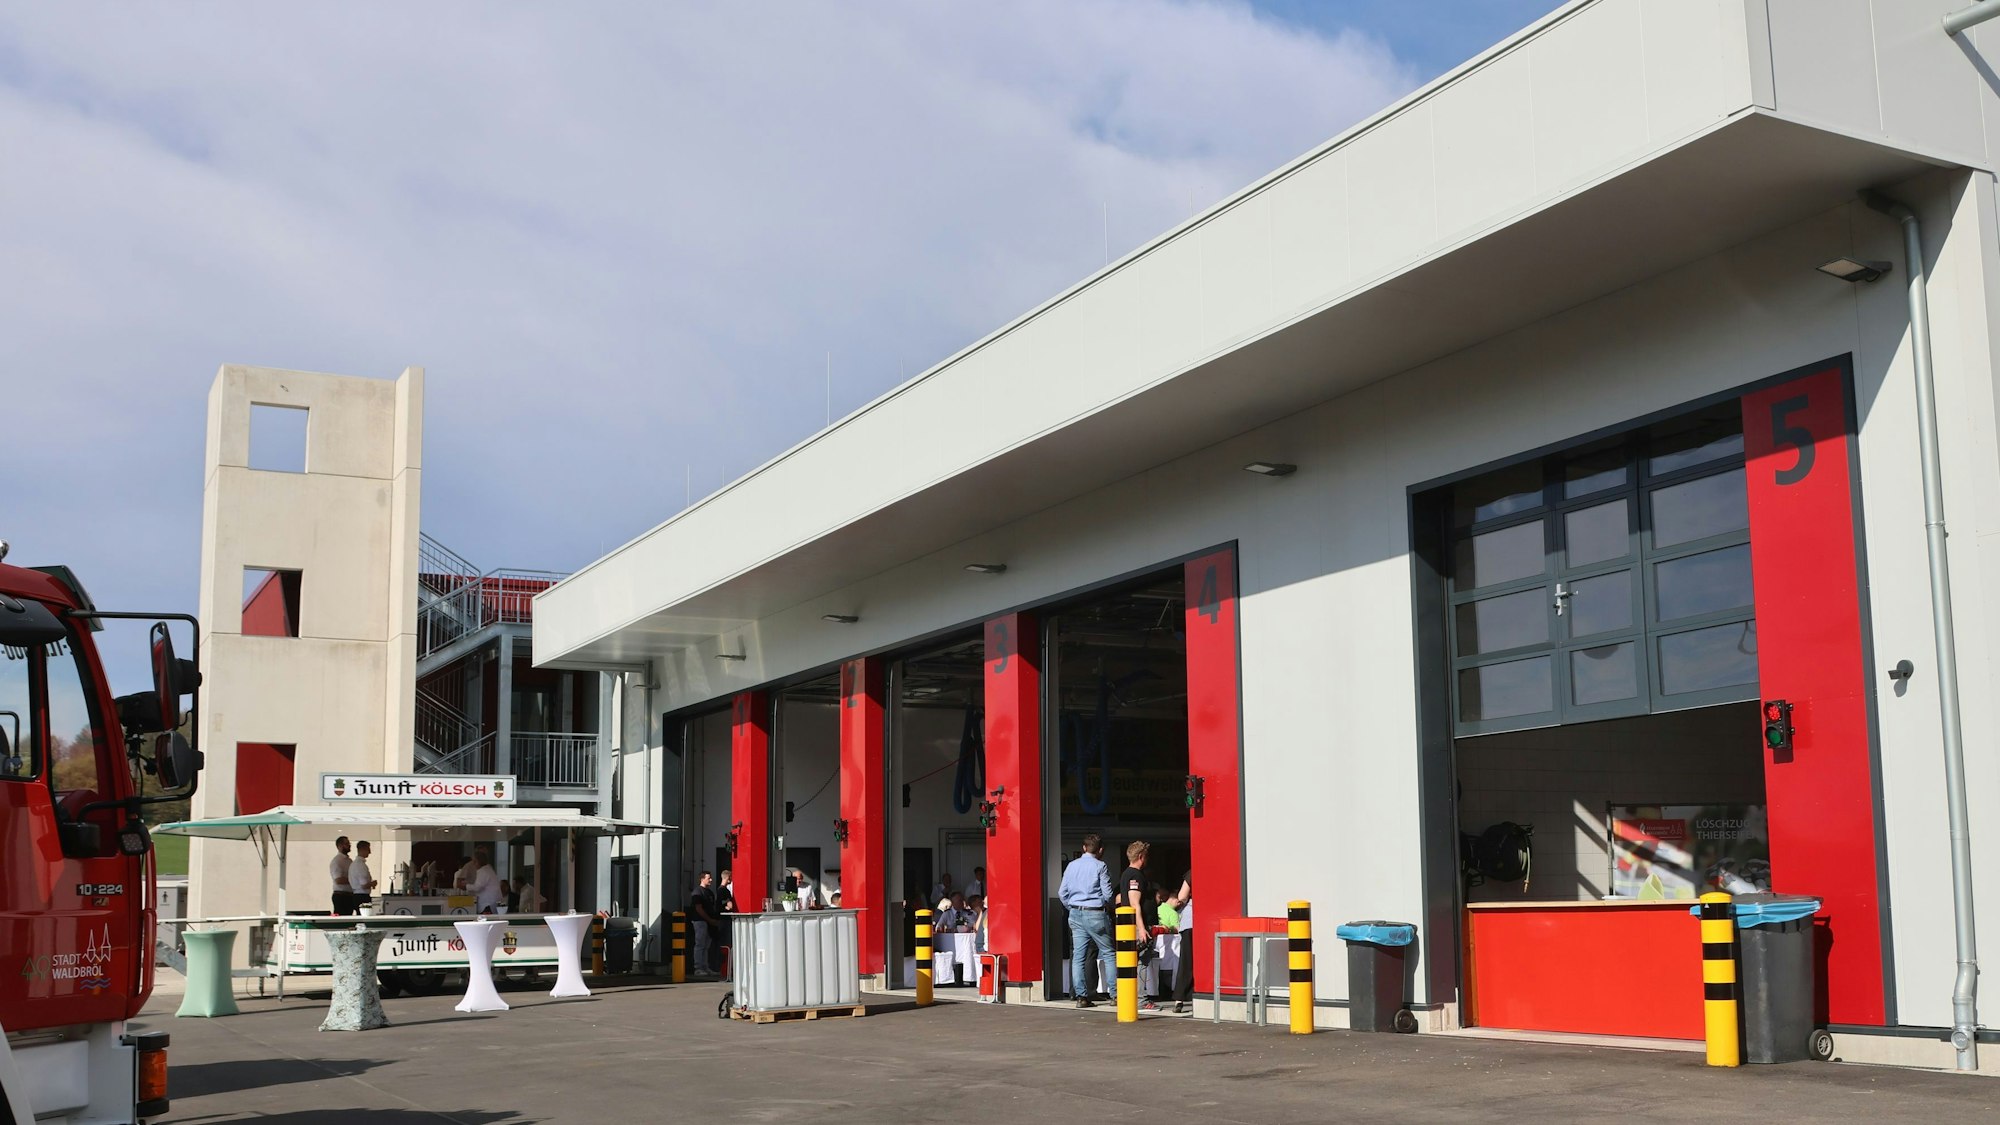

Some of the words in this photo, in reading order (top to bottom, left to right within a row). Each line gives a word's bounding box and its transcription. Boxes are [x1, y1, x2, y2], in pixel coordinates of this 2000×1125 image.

[1770, 393, 1816, 485] 5
[1198, 565, 1221, 624] 4
[994, 623, 1008, 674] 3
[847, 664, 857, 707] 2
[738, 701, 744, 736] 1
[354, 780, 416, 795] Zunft
[420, 782, 486, 795] KÖLSCH
[1696, 817, 1751, 829] LÖSCHZUG
[392, 933, 440, 957] Zunft
[52, 954, 81, 966] STADT
[52, 963, 104, 979] WALDBRÖL
